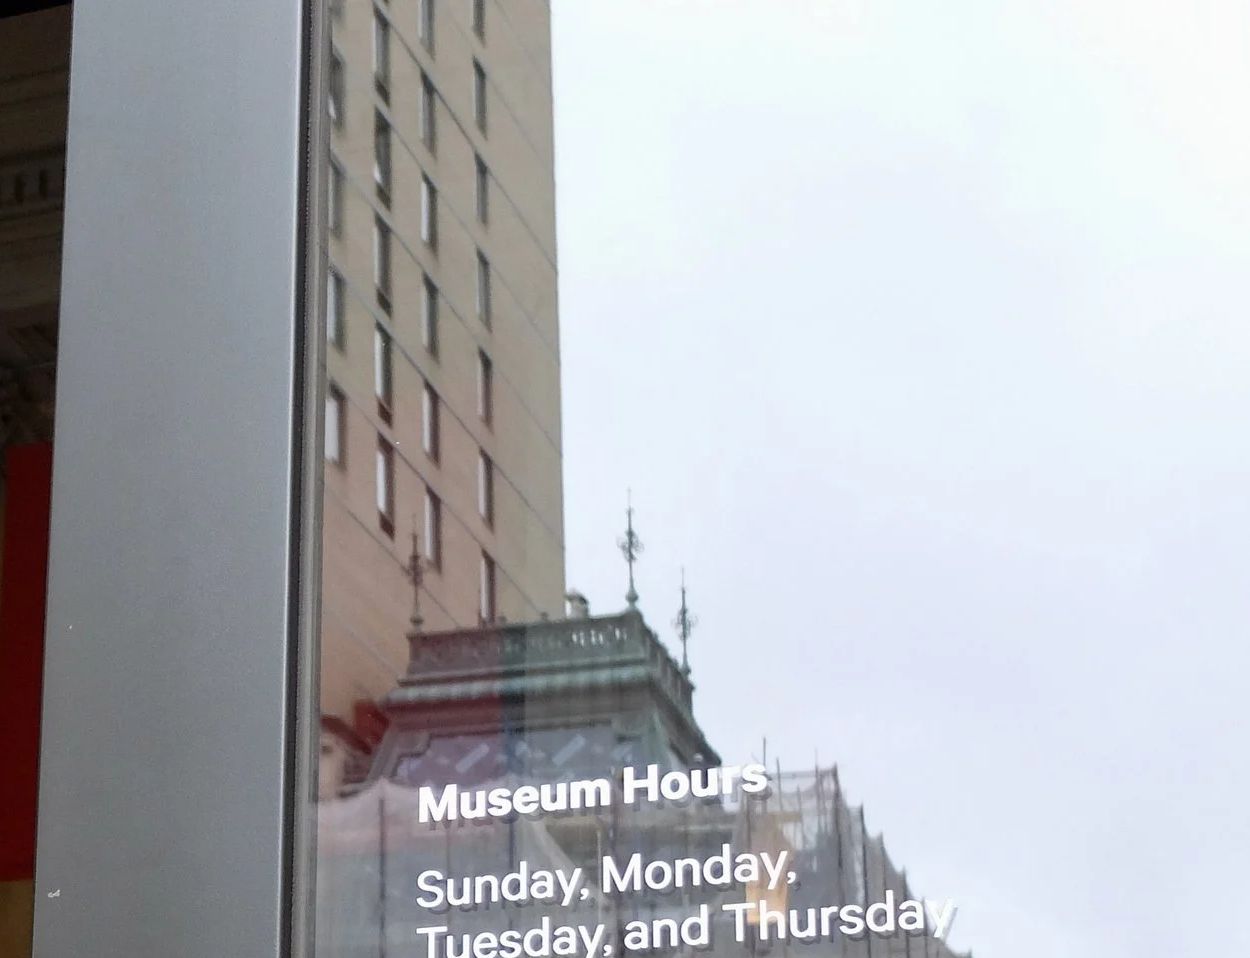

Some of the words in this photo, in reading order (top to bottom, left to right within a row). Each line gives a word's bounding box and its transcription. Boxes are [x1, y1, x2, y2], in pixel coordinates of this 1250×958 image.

[419, 779, 610, 822] Museum
[623, 763, 769, 804] Hours
[417, 861, 589, 907] Sunday,
[603, 844, 796, 892] Monday,
[625, 905, 708, 949] and
[722, 889, 954, 938] Thursday
